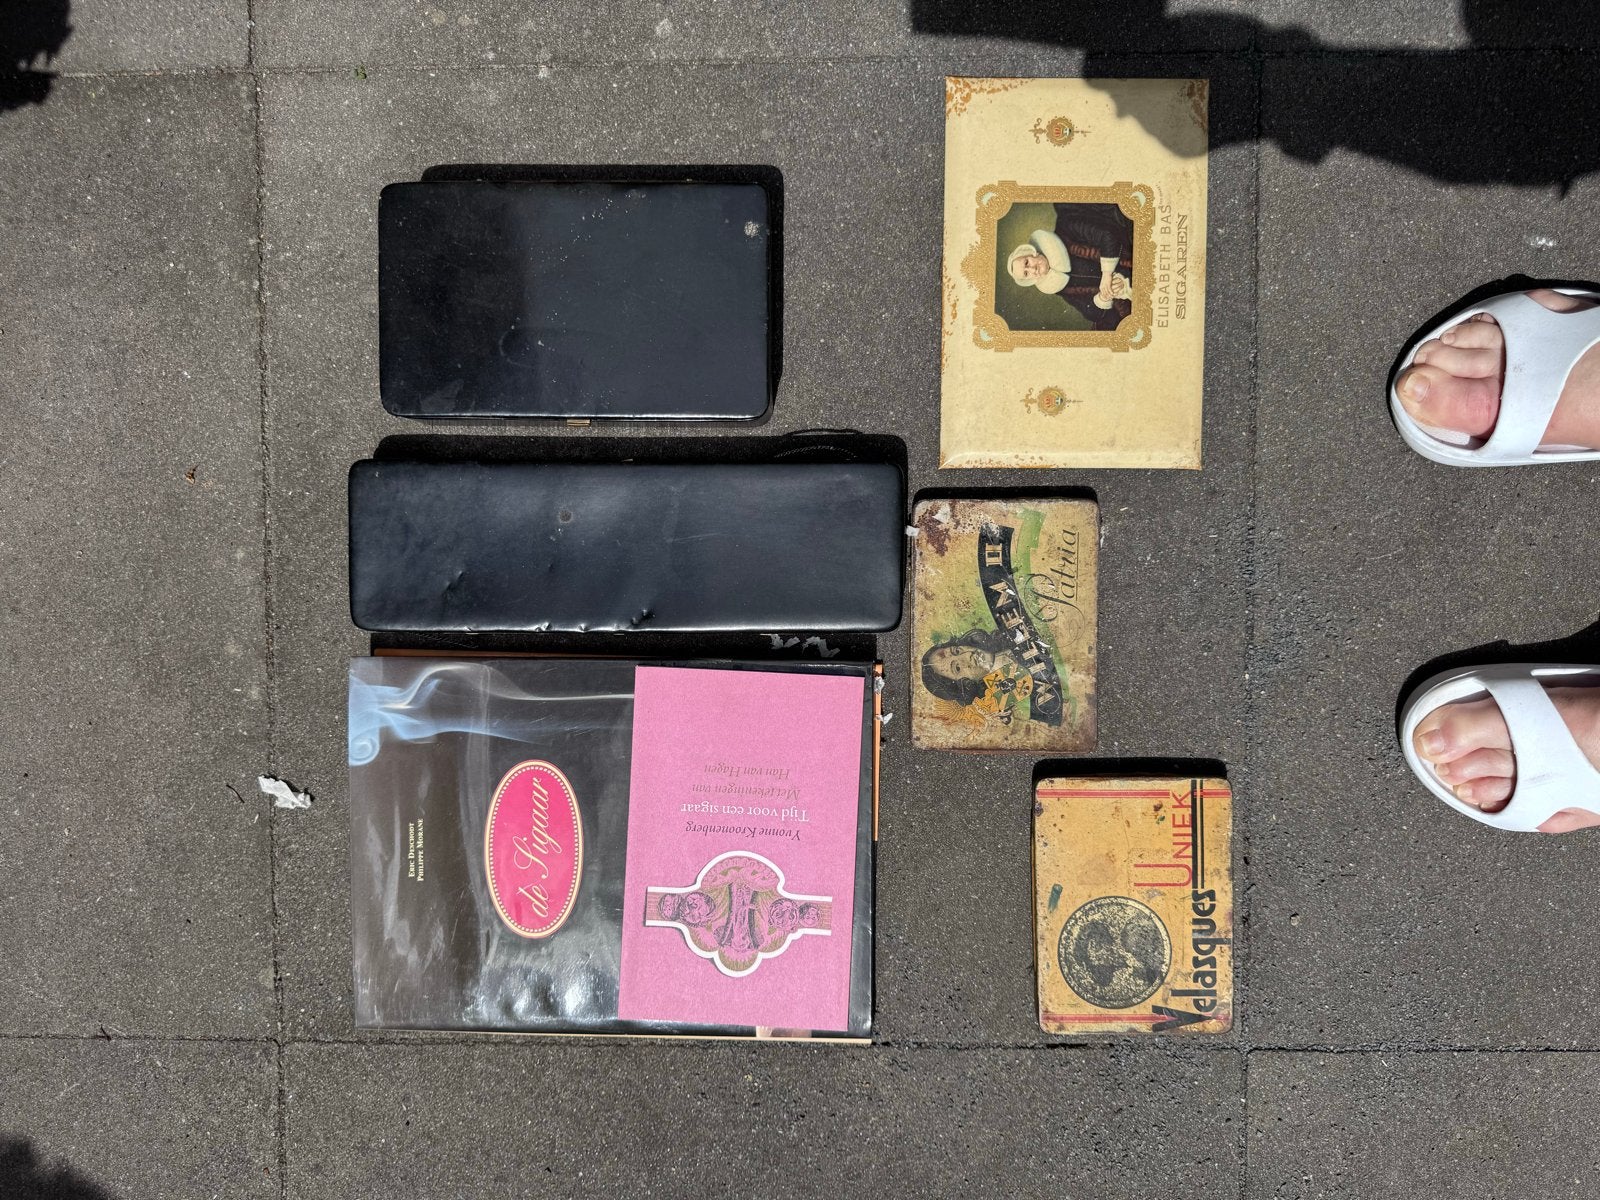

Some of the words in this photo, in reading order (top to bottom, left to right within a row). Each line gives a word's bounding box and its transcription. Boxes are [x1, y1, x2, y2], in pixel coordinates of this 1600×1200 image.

[1160, 204, 1172, 235] BAS
[1175, 213, 1188, 320] SIGAREN
[1157, 243, 1171, 328] ELISABETH
[985, 543, 1002, 567] II
[1024, 529, 1085, 646] Patria
[989, 579, 1056, 706] WILLEM
[703, 761, 740, 777] Hagen
[743, 765, 763, 775] van
[765, 767, 790, 780] Han
[691, 784, 712, 793] van
[714, 783, 775, 798] tekeningen
[777, 787, 801, 800] Met
[680, 800, 719, 816] sigaar
[722, 805, 744, 814] een
[747, 807, 778, 817] voor
[781, 806, 810, 822] Tijd
[416, 818, 424, 848] MORANE
[512, 777, 562, 880] Sigaar
[685, 821, 757, 838] Kroonenberg
[759, 828, 801, 841] Yvonne
[516, 882, 550, 918] de
[1152, 888, 1231, 1033] Velasques
